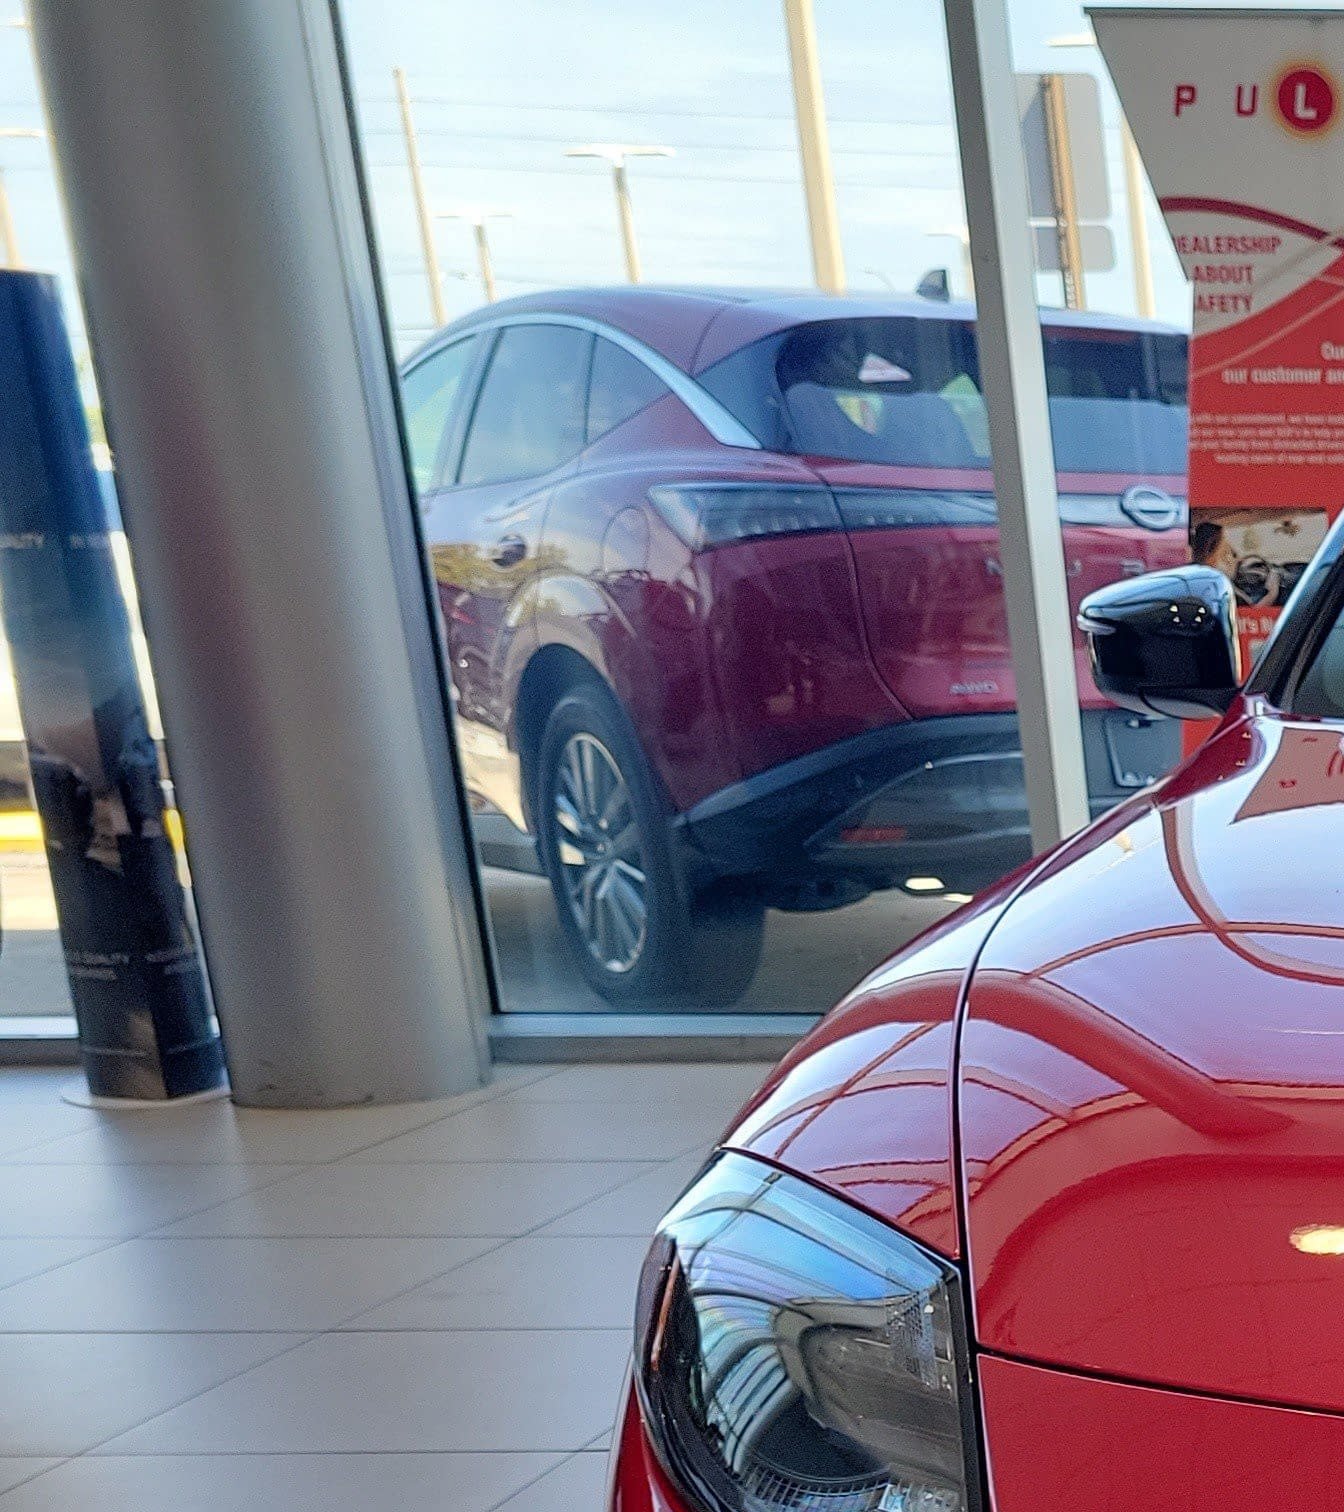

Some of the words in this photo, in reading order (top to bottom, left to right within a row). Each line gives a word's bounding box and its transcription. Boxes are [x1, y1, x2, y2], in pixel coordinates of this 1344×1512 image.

[1194, 264, 1252, 283] ABOUT
[1195, 293, 1252, 313] AFETY
[1222, 369, 1247, 384] our
[1251, 368, 1321, 384] customer
